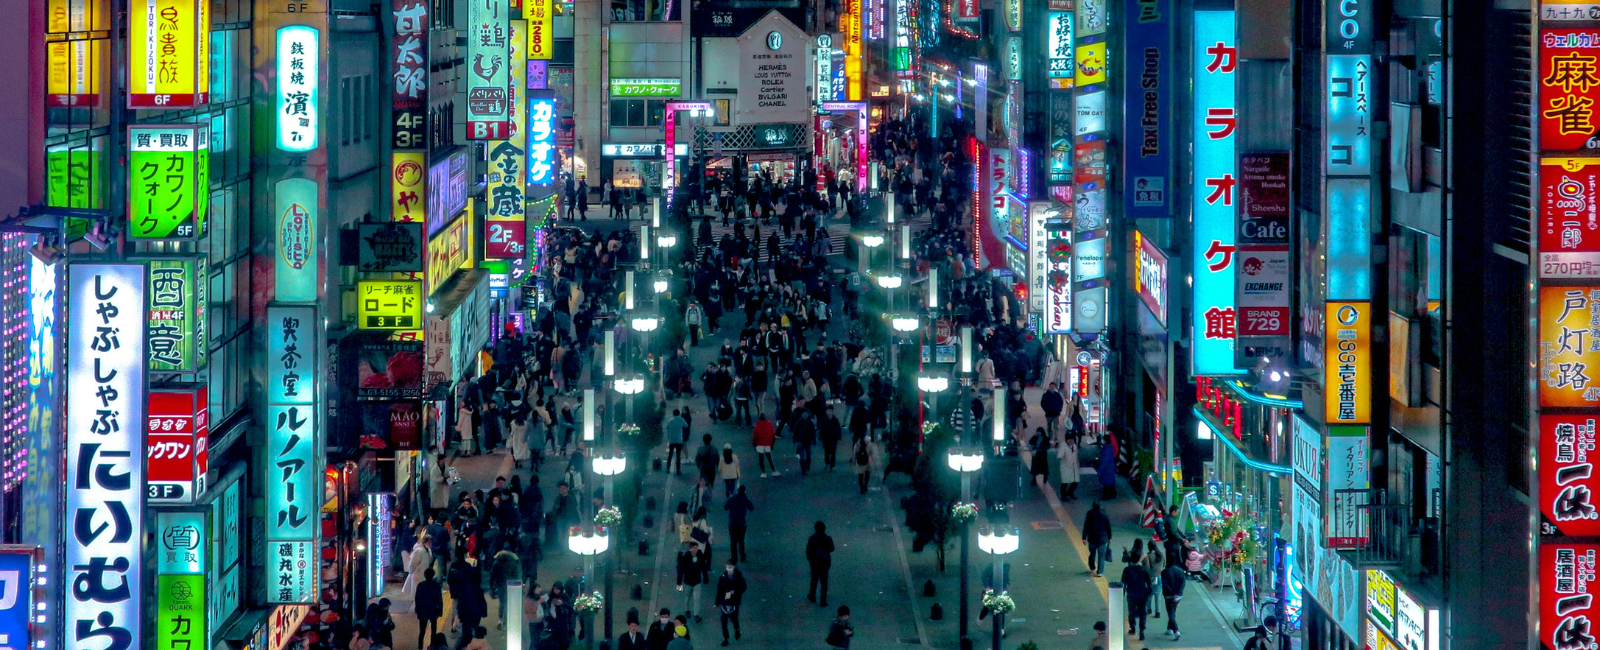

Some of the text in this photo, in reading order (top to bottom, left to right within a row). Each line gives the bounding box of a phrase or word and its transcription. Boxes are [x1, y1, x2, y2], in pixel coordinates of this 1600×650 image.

[287, 3, 308, 13] 6F
[1546, 7, 1586, 19] 九十九
[851, 0, 862, 44] Matsumo
[533, 25, 542, 53] 280
[1343, 40, 1355, 49] 4F
[1543, 32, 1600, 48] ウェルカム
[393, 2, 427, 98] 甘太郎
[290, 41, 305, 86] 鉄板焼
[754, 71, 792, 79] LOUIS VUITTON
[624, 86, 678, 94] カワノ・クォーク
[1356, 60, 1368, 136] ヘアースペース
[1542, 51, 1600, 135] 麻雀
[154, 94, 171, 105] 6F
[1141, 47, 1159, 158] Tax Free Shop
[397, 112, 423, 129] 4F
[1331, 77, 1354, 166] ココ
[396, 131, 422, 147] 3F
[474, 121, 499, 139] B1
[137, 133, 188, 148] 質・買取
[531, 101, 552, 182] カラオケ
[1567, 159, 1580, 170] 5F
[489, 141, 525, 217] 金の蔵
[993, 154, 1006, 209] トラノコ
[1261, 181, 1286, 189] Hookah
[140, 161, 160, 235] クォーク
[1139, 191, 1163, 201] 免税
[1203, 41, 1237, 340] カラオケ館
[1251, 204, 1286, 212] Sheesha
[1546, 184, 1554, 235] TORIJIRO
[177, 226, 193, 236] 5F
[489, 224, 513, 243] 2F
[1241, 220, 1287, 239] Cafe
[366, 285, 415, 295] リーチ麻雀
[1244, 282, 1284, 291] EXCHANGE
[365, 297, 415, 313] ロード
[1247, 310, 1281, 318] BRAND
[377, 316, 402, 327] 3F
[1246, 318, 1281, 331] 729
[1556, 290, 1591, 390] 戸灯路
[90, 274, 121, 436] しゃぶしゃぶ
[281, 316, 302, 397] 喫茶室
[1541, 342, 1557, 388] TOTORO
[1337, 339, 1357, 421] CoCo壱番屋
[149, 418, 187, 431] ラオケ
[390, 411, 420, 422] MAO
[1555, 423, 1575, 463] 焼鳥
[276, 406, 308, 529] ルノアール
[148, 485, 173, 498] 3F
[1553, 463, 1596, 521] 一休
[1541, 522, 1557, 535] 3F
[166, 552, 198, 563] 買取
[279, 542, 293, 602] 磯丸水産
[1555, 548, 1575, 594] 居酒屋
[1553, 593, 1596, 650] 一休
